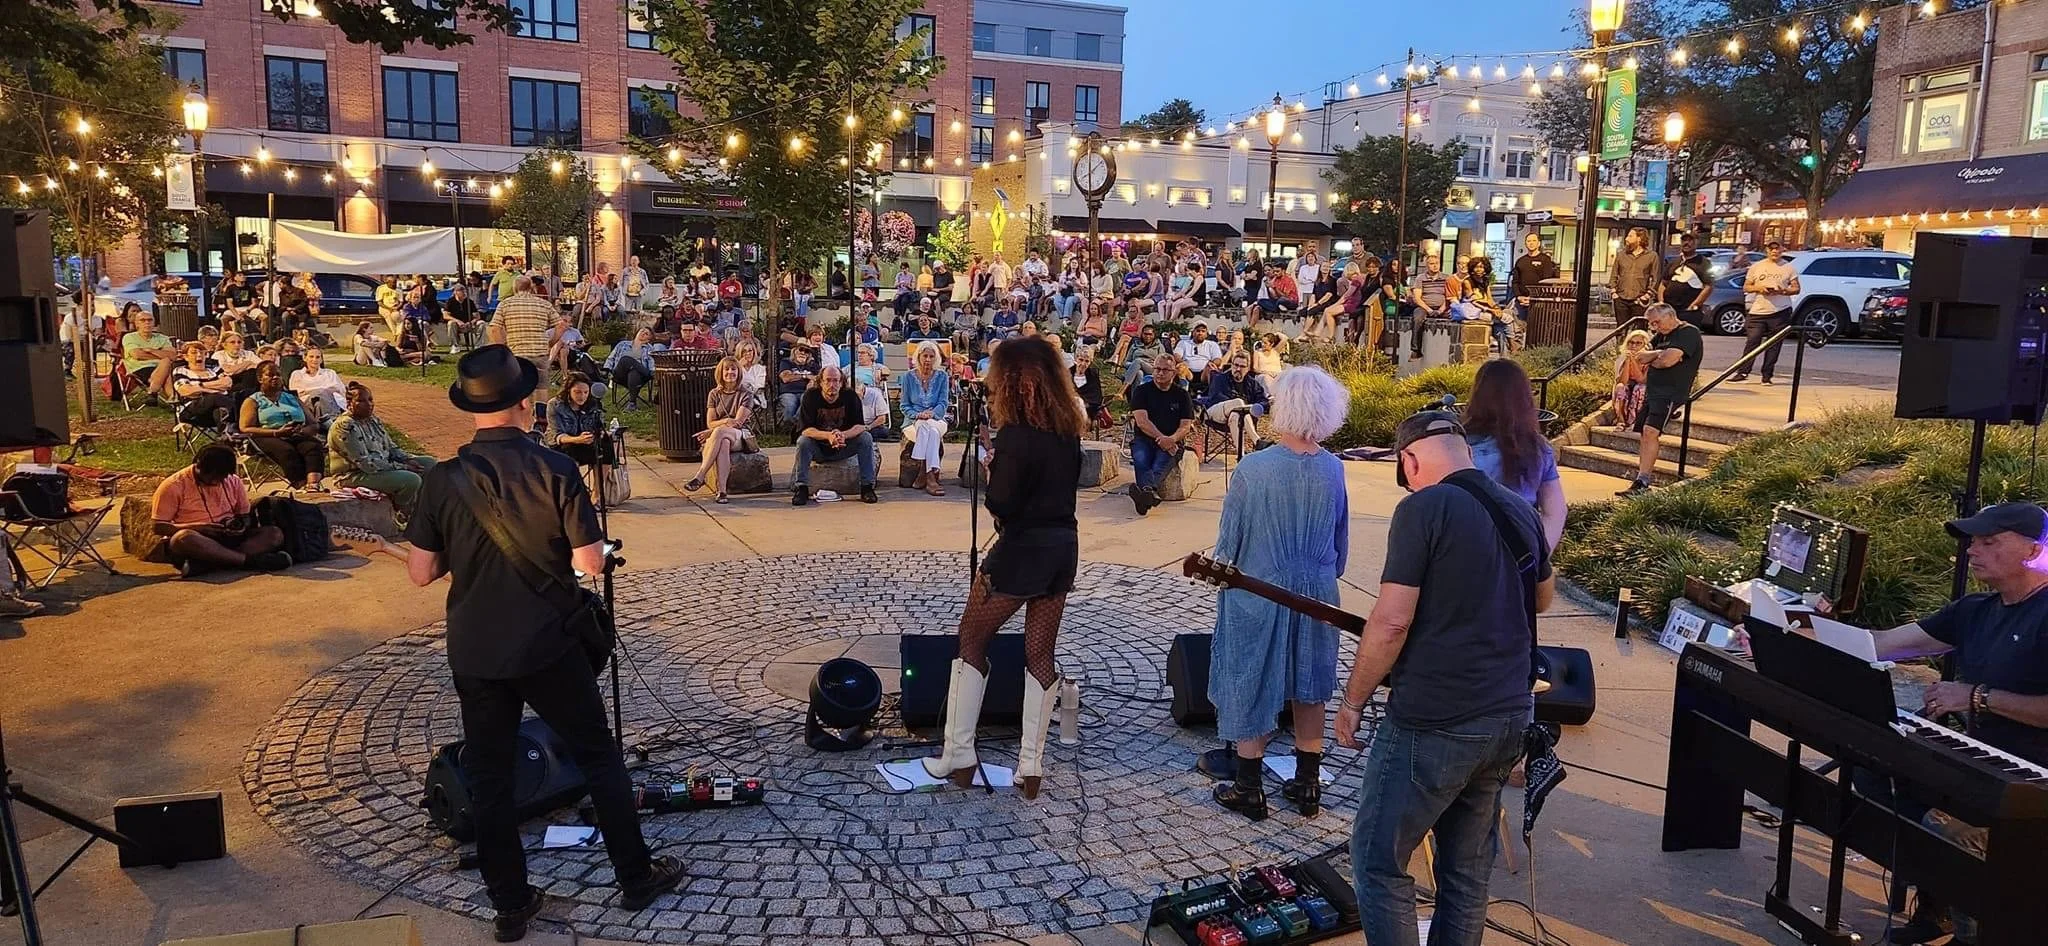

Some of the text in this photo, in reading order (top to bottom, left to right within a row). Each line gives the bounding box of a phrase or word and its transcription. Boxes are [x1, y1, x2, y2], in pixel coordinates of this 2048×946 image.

[1606, 133, 1625, 141] SOUTH
[1606, 139, 1629, 148] ORANGE
[1694, 659, 1723, 684] YAMAHA
